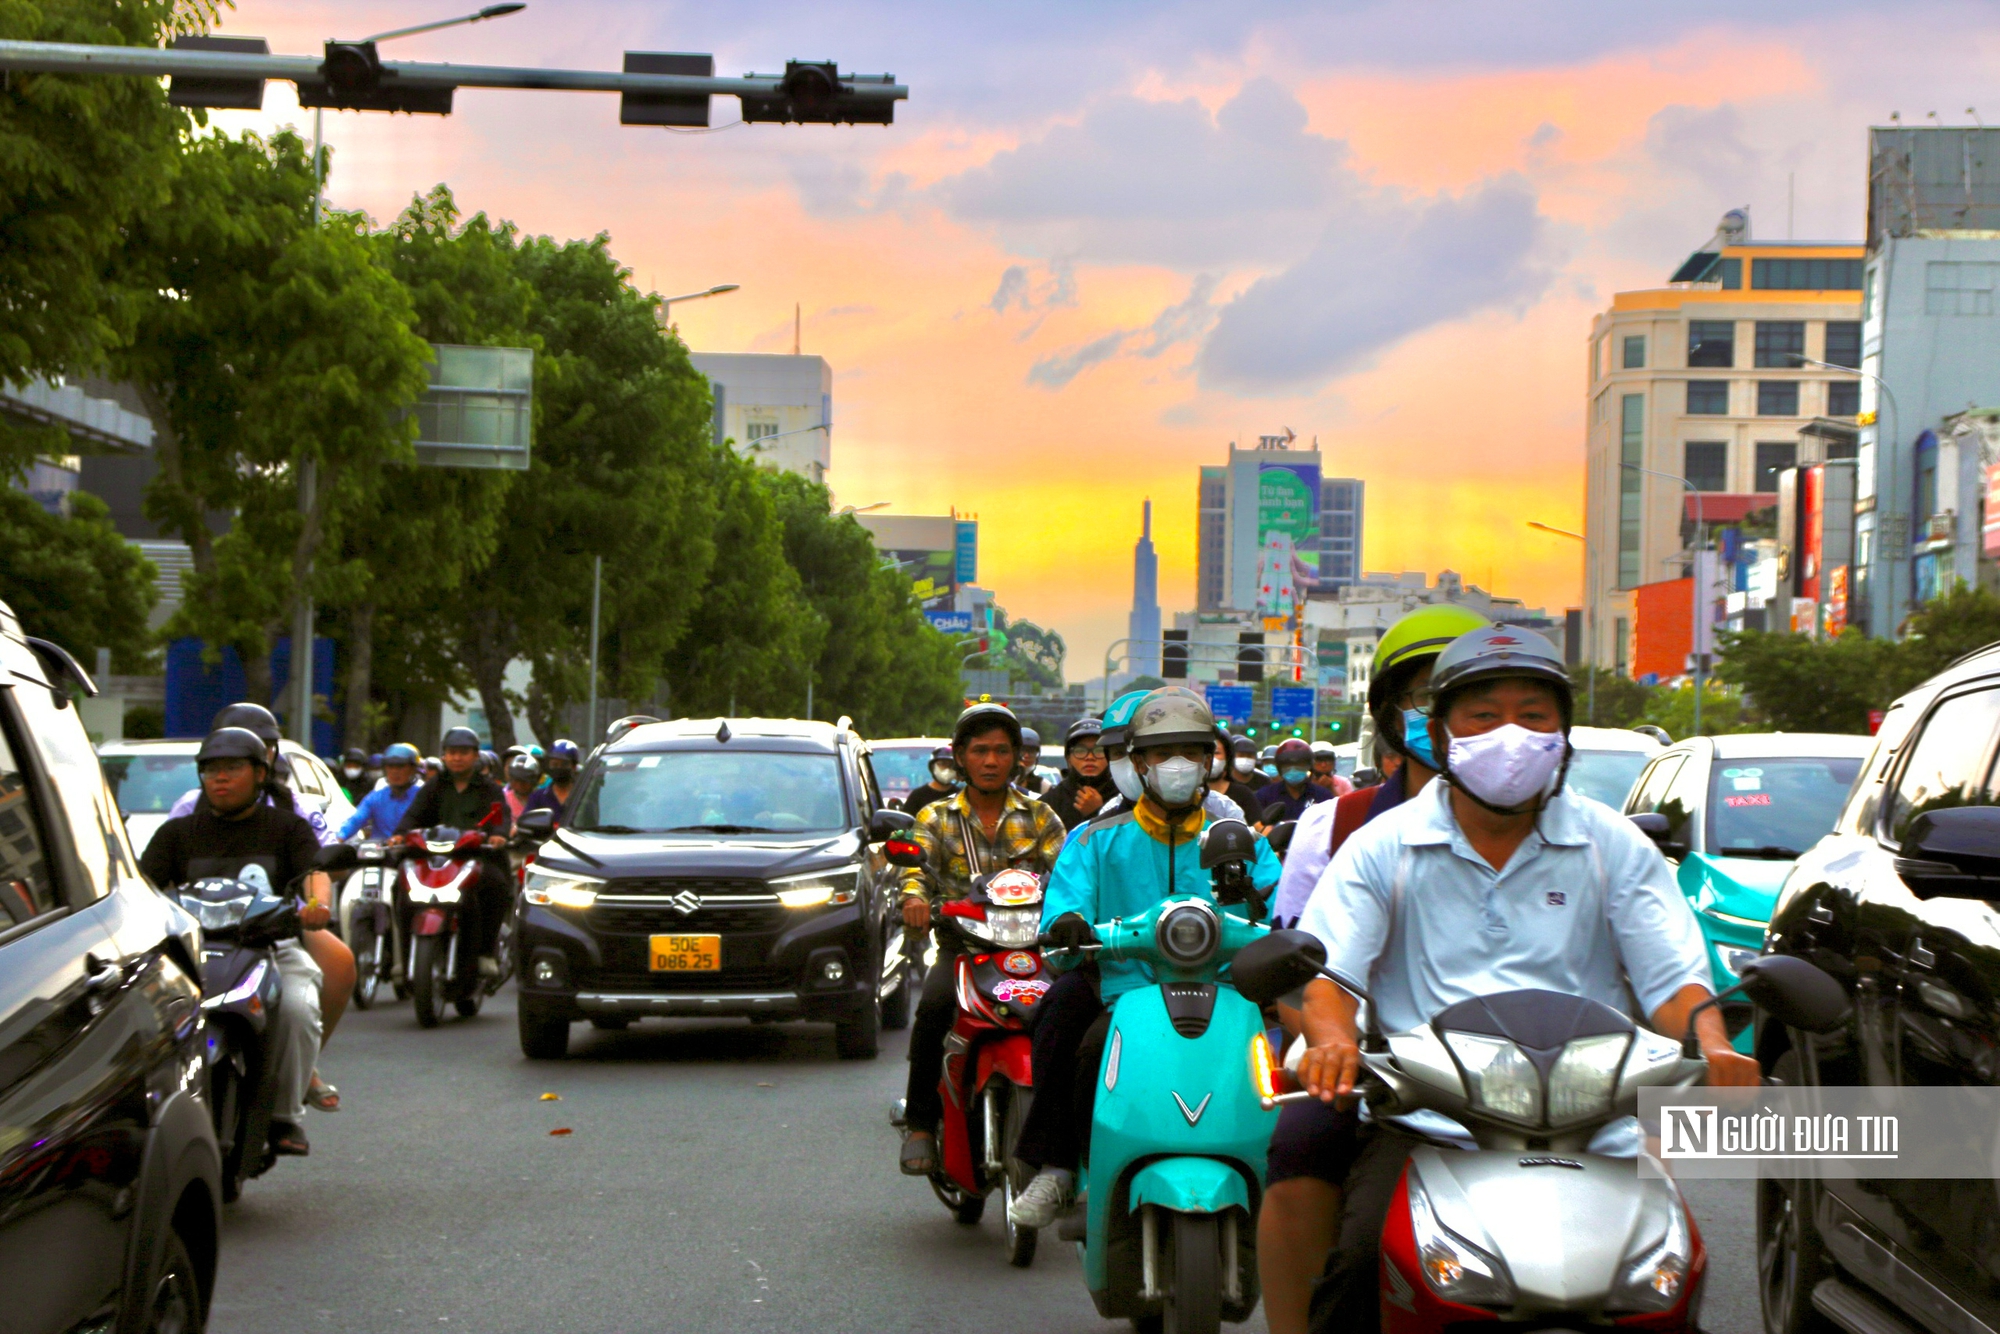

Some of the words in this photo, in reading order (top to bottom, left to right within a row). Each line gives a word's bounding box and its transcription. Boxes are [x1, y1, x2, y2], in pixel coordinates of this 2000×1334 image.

[1259, 435, 1288, 450] TTC
[1724, 794, 1771, 808] TAXI
[670, 936, 700, 952] 50E
[657, 953, 713, 969] 086.25
[1171, 990, 1209, 998] VINFAST
